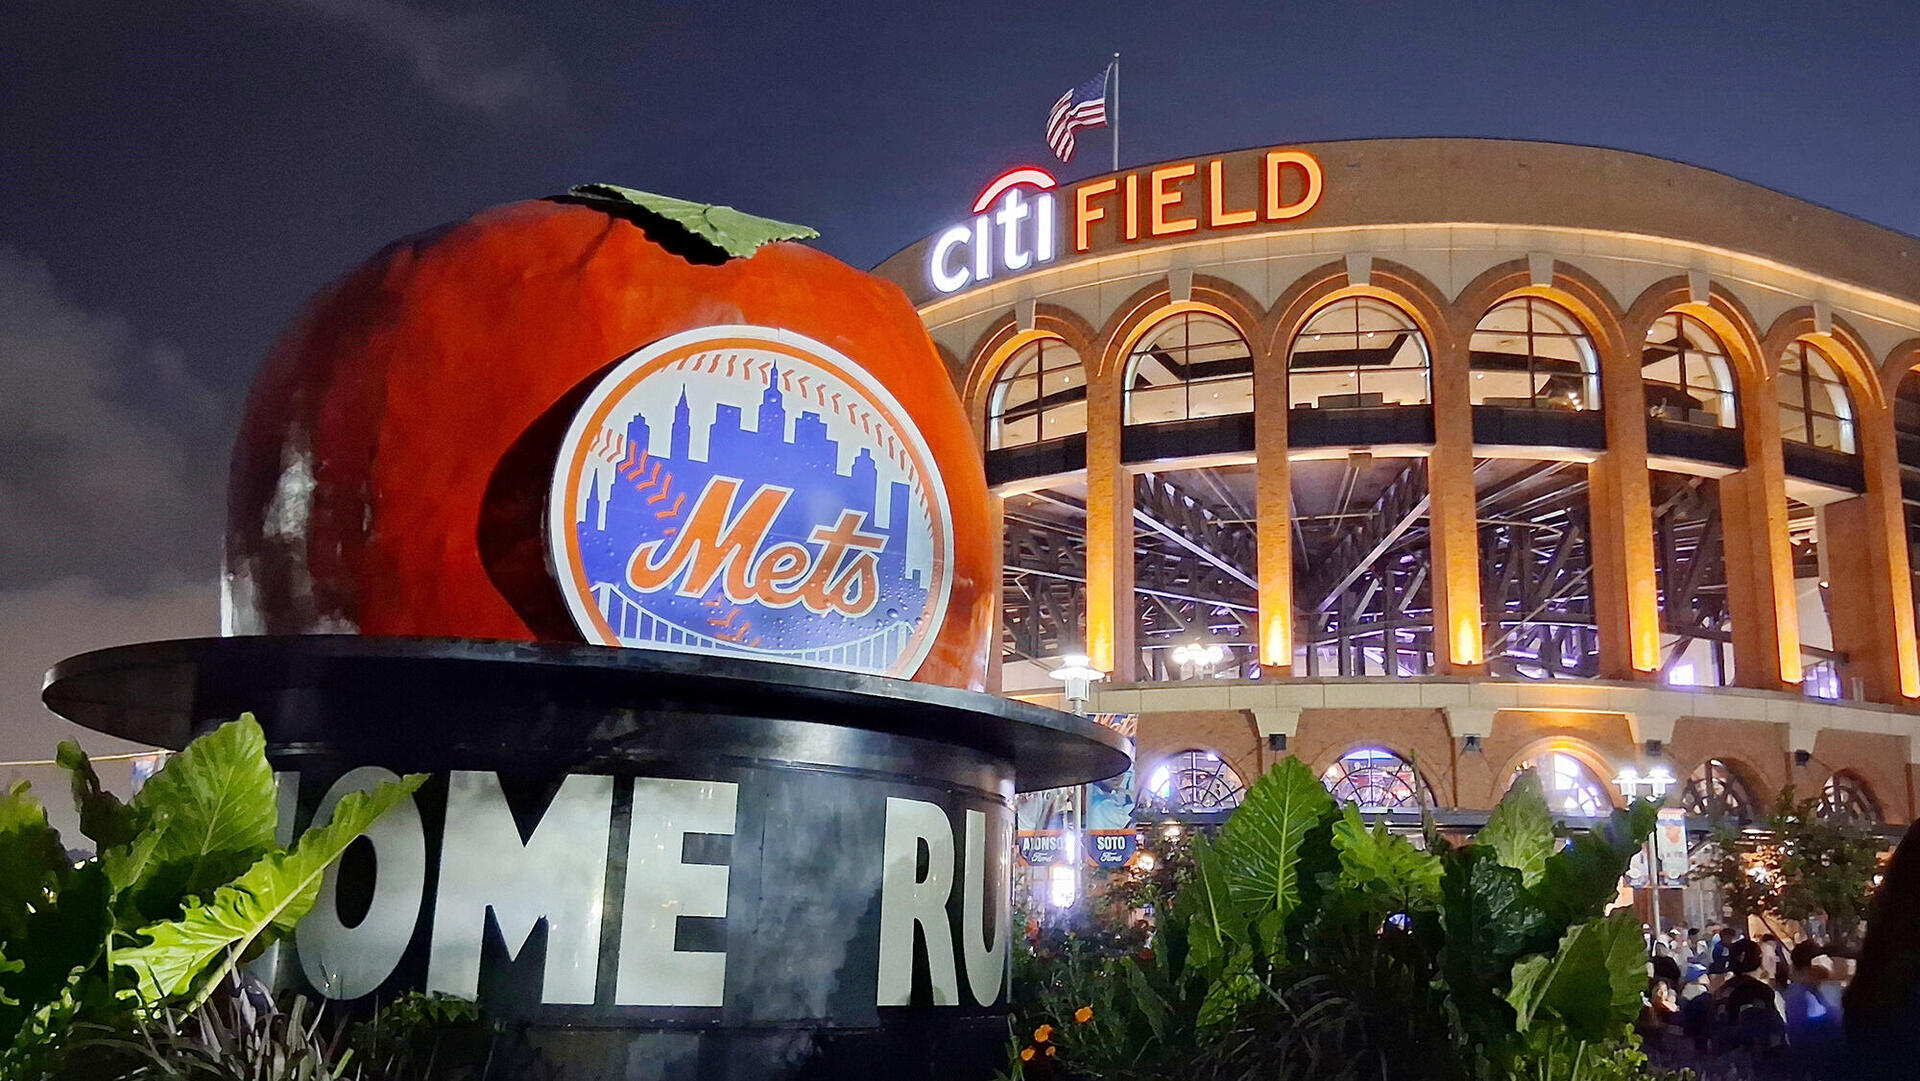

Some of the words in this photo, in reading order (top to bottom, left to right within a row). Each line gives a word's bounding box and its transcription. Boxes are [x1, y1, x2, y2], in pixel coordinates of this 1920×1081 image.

[930, 166, 1056, 293] citi
[1075, 151, 1323, 251] FIELD
[625, 474, 890, 618] Mets
[1097, 836, 1126, 850] SOTO
[1100, 852, 1122, 863] Ford
